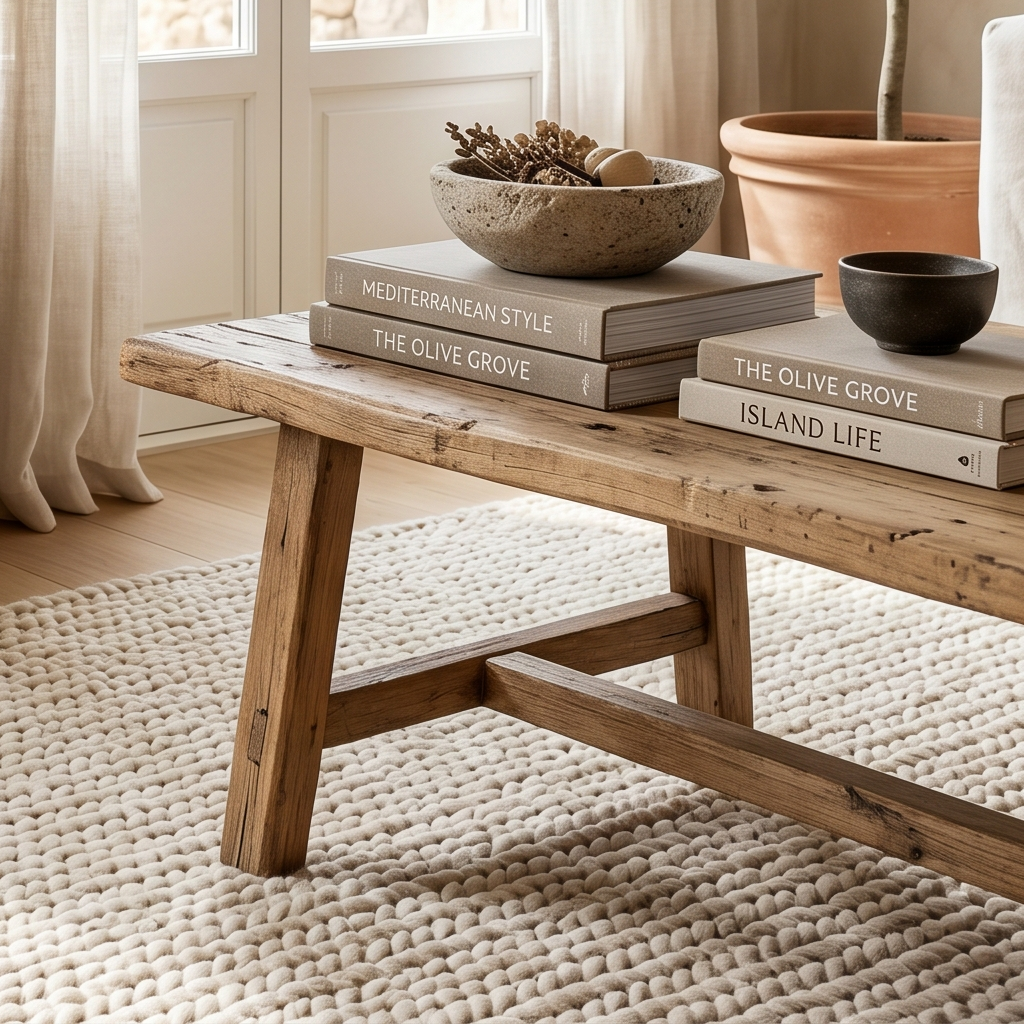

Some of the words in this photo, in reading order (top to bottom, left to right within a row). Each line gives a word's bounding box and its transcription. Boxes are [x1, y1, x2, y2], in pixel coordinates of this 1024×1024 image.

[361, 278, 497, 323] MEDITERRANEAN
[500, 306, 553, 334] STYLE
[372, 329, 406, 354] THE
[411, 337, 462, 366] OLIVE
[467, 349, 531, 381] GROVE
[733, 357, 773, 383] THE
[778, 367, 839, 396] OLIVE
[844, 380, 919, 413] GROVE
[740, 402, 824, 440] ISLAND
[833, 421, 882, 453] LIFE
